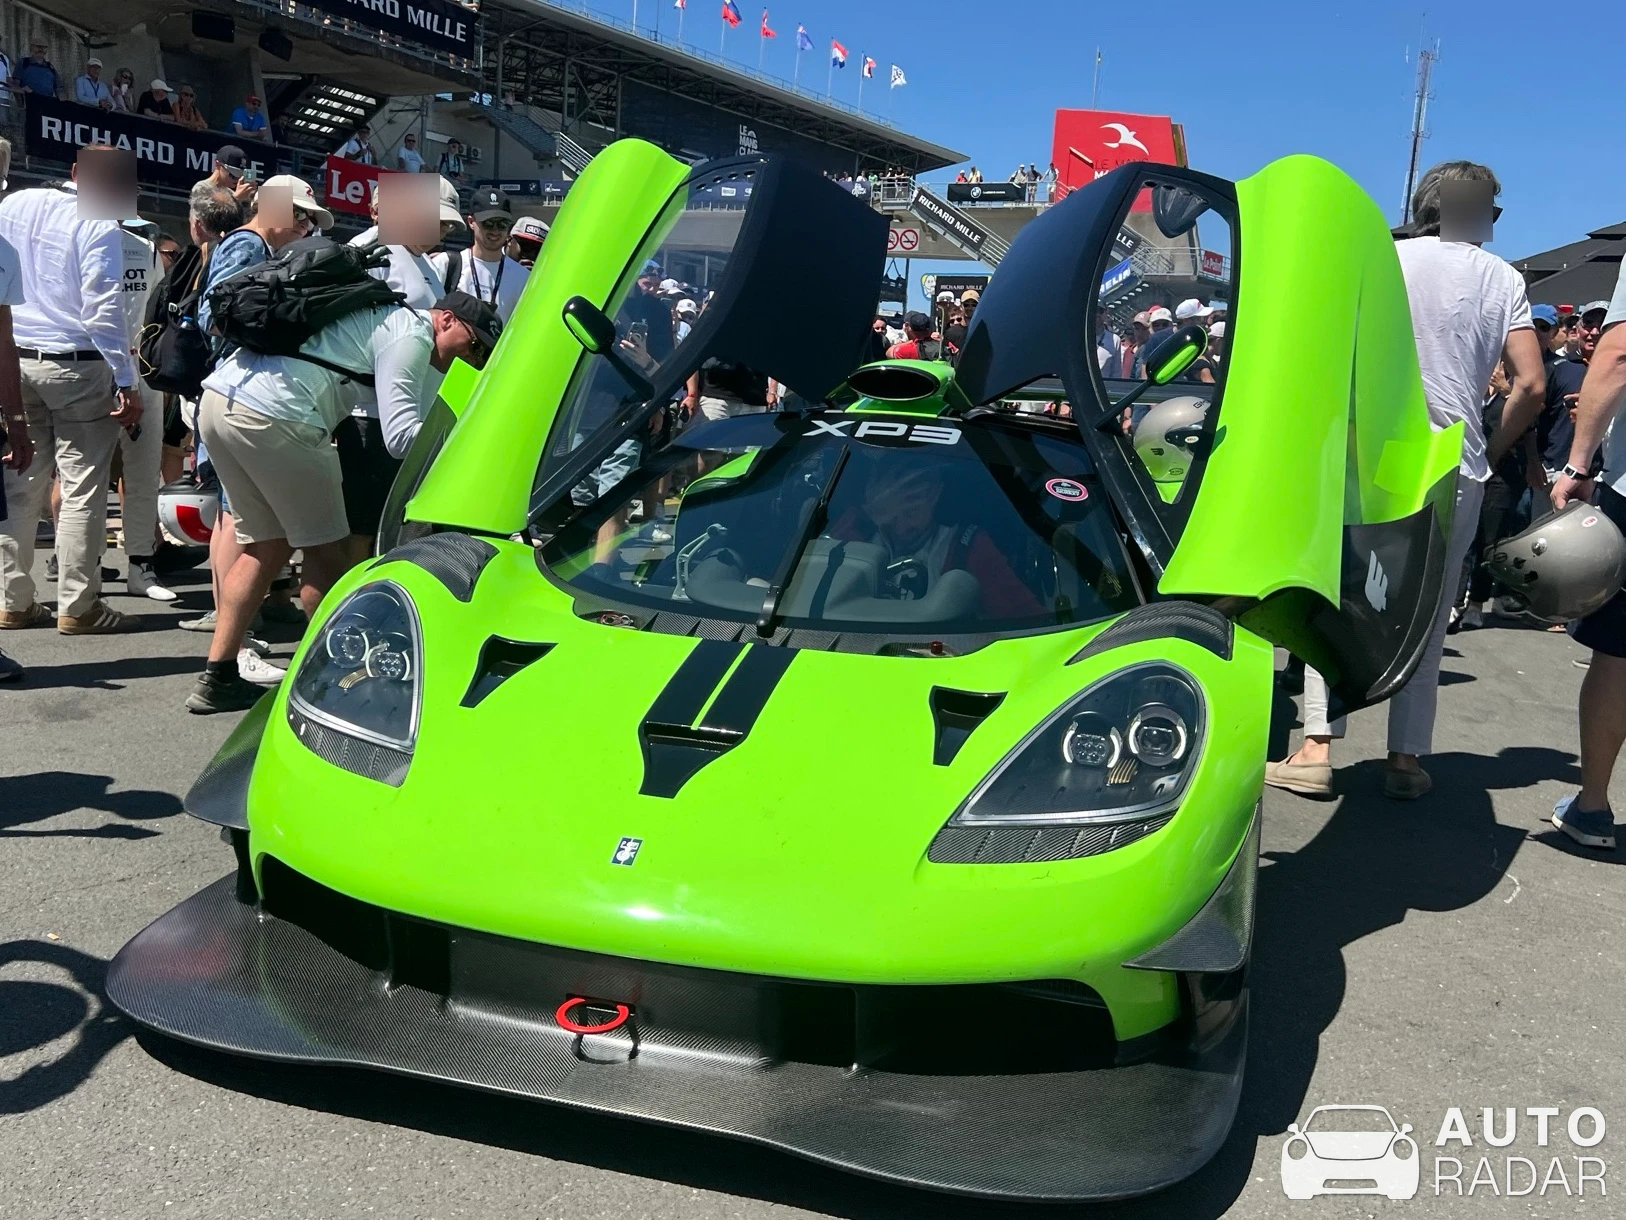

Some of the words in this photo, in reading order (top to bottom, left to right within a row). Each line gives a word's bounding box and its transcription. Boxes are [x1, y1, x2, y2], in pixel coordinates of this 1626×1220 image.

[407, 5, 467, 42] MILLE
[739, 124, 748, 136] LE
[41, 116, 174, 165] RICHARD
[186, 148, 265, 182] MIE
[739, 135, 758, 149] MANS
[1095, 159, 1109, 170] LE
[330, 169, 365, 204] Le
[918, 194, 955, 225] RICHARD
[953, 211, 982, 244] MILLE
[1115, 232, 1134, 249] LLE
[123, 268, 146, 280] OT
[122, 282, 148, 292] HES
[802, 419, 963, 445] XP3
